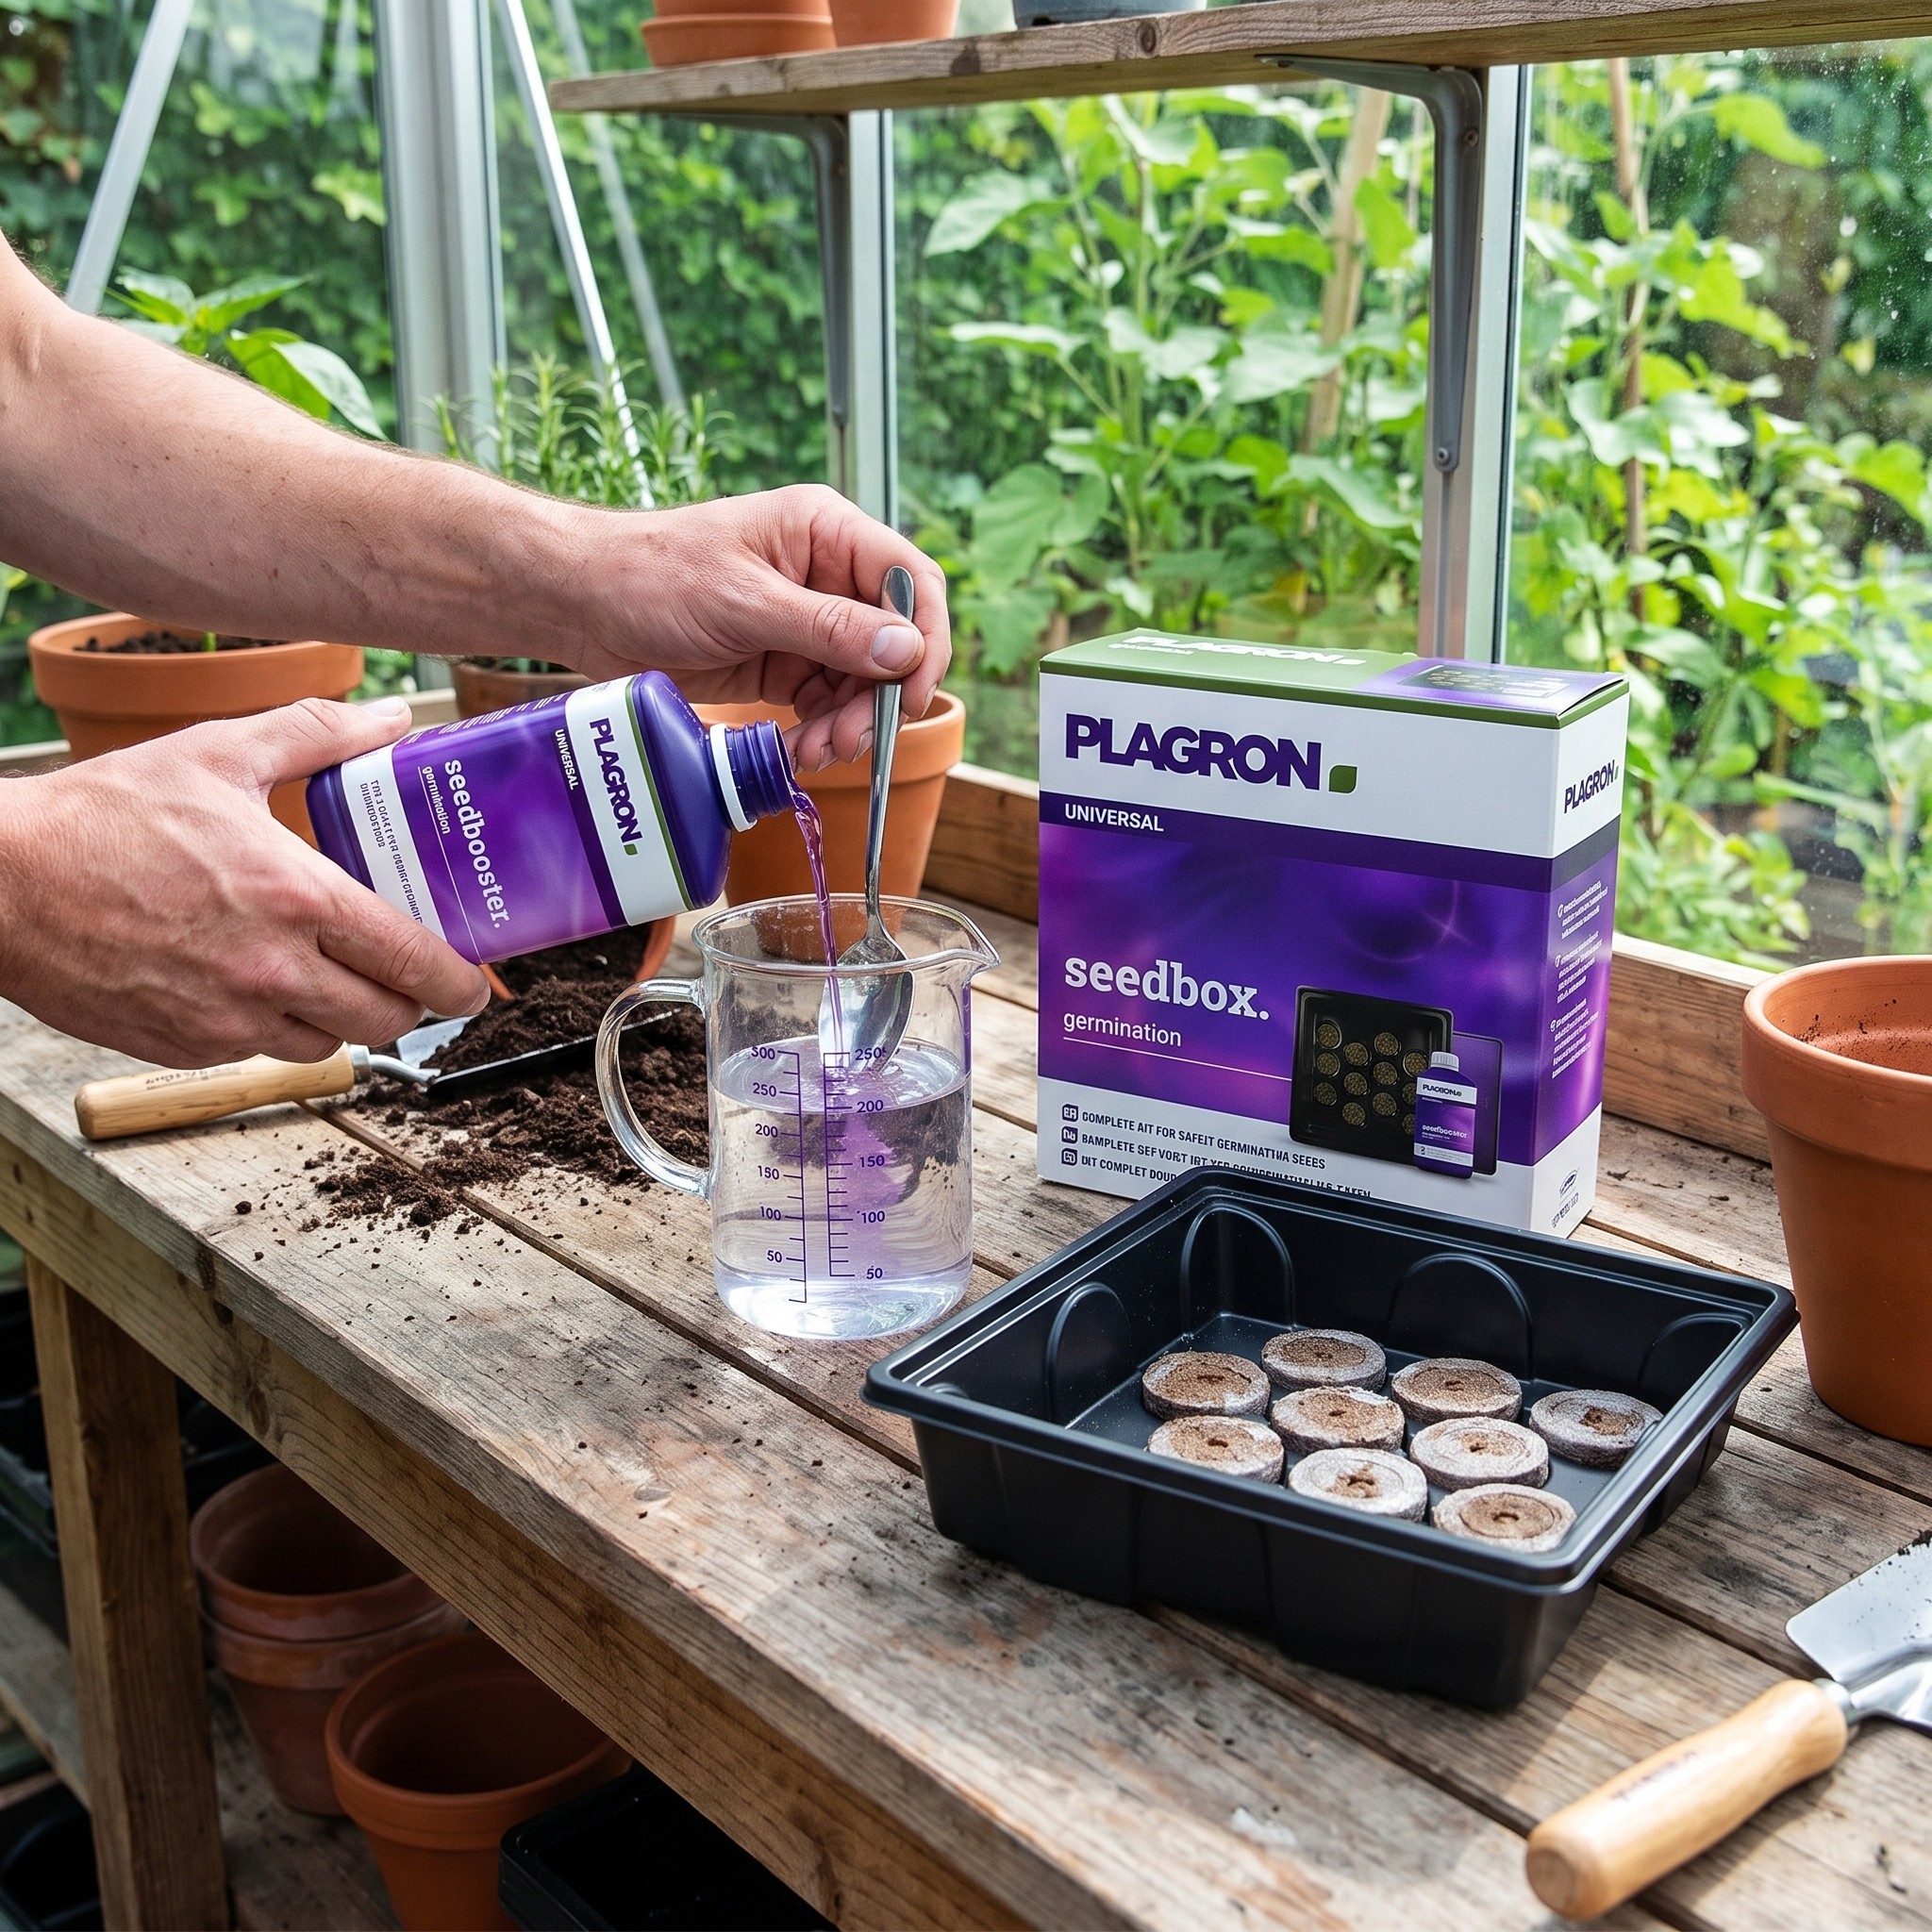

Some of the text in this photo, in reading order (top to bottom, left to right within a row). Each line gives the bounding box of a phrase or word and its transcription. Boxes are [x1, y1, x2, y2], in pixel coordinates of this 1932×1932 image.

[555, 728, 580, 791] UNIVERSAL
[1065, 713, 1322, 791] PLAGRON
[590, 717, 643, 842] PLAGRON
[1563, 758, 1615, 814] PLAGRON
[1064, 803, 1164, 833] UNIVERSAL
[444, 759, 510, 929] seedbooster.
[1064, 956, 1271, 1021] seedbox.
[1063, 1010, 1182, 1048] germination
[753, 1082, 777, 1097] 250
[857, 1099, 884, 1113] 200
[755, 1124, 778, 1138] 200
[1156, 1125, 1176, 1140] FOR
[1082, 1134, 1135, 1154] BAMPLETE
[859, 1155, 885, 1168] 150
[1099, 1158, 1148, 1178] COMPLET
[758, 1166, 779, 1180] 150
[760, 1206, 781, 1221] 100
[861, 1210, 885, 1224] 100
[767, 1251, 782, 1263] 50
[866, 1268, 883, 1279] 50
